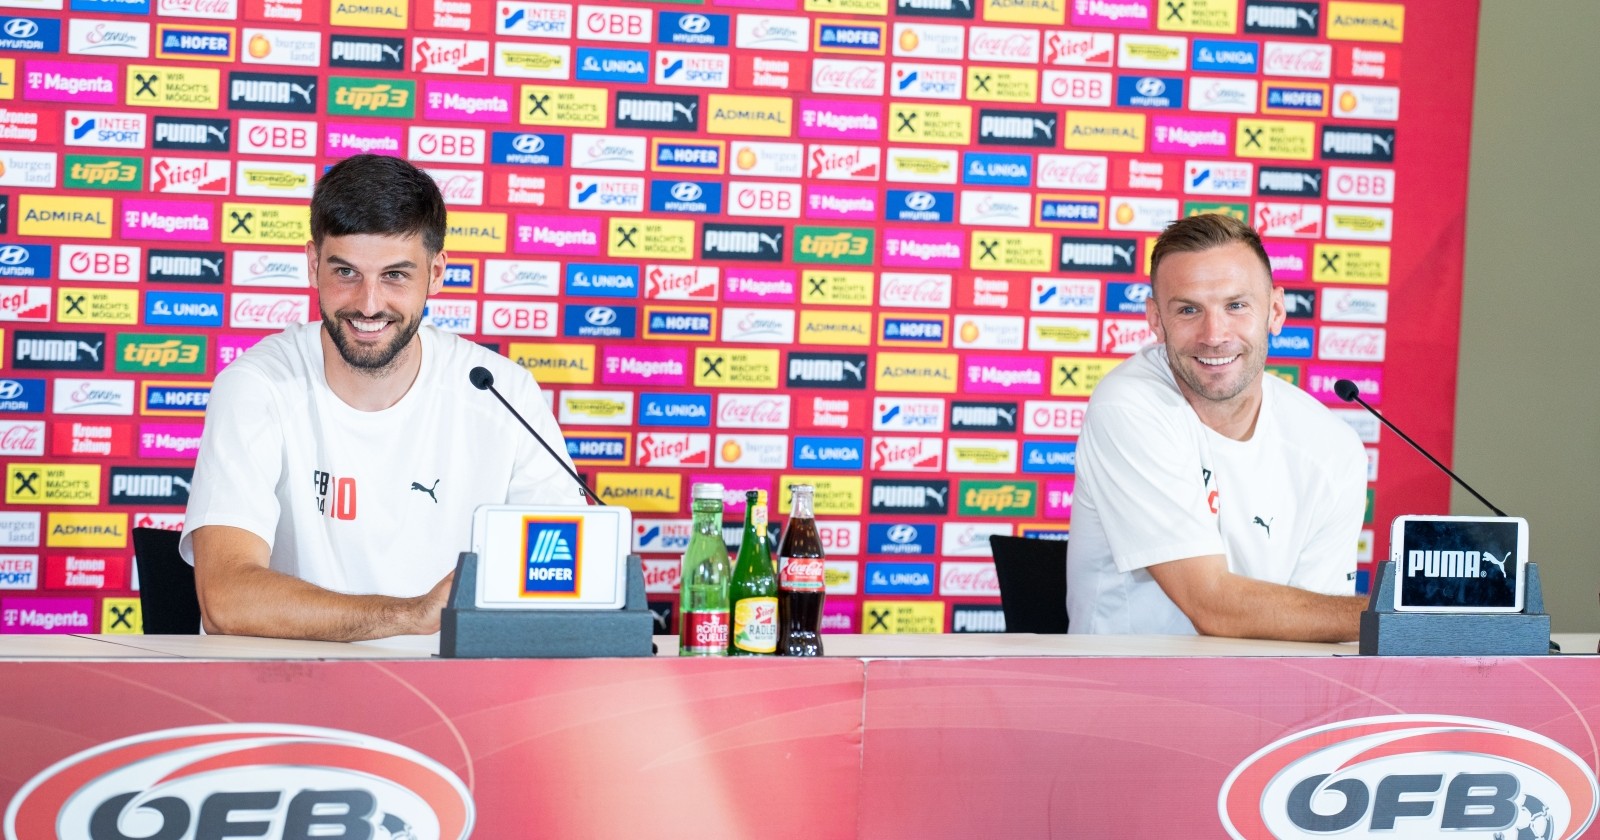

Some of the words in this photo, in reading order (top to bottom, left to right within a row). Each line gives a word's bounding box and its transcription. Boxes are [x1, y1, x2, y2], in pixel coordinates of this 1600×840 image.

[264, 3, 302, 21] Zeitung
[337, 4, 402, 18] ADMIRAL
[528, 10, 566, 20] INTER
[1247, 6, 1297, 28] PUMA
[528, 21, 565, 32] SPORT
[181, 36, 227, 50] HOFER
[276, 37, 315, 49] burgen
[837, 31, 878, 44] HOFER
[290, 51, 315, 62] land
[332, 41, 382, 61] PUMA
[412, 41, 467, 72] Stiegl
[1046, 34, 1094, 64] Stiegl
[603, 61, 644, 74] UNIQA
[686, 59, 724, 70] INTER
[686, 71, 722, 81] SPORT
[922, 70, 956, 80] INTER
[45, 74, 113, 94] Magenta
[231, 80, 291, 103] PUMA
[335, 85, 409, 110] tipp3
[444, 93, 507, 113] Magenta
[618, 100, 674, 122] PUMA
[714, 109, 785, 123] ADMIRAL
[100, 118, 140, 130] INTER
[817, 111, 878, 131] Magenta
[981, 116, 1033, 138] PUMA
[99, 131, 139, 143] SPORT
[156, 123, 207, 143] PUMA
[1072, 124, 1138, 139] ADMIRAL
[342, 133, 398, 151] Magenta
[507, 154, 549, 164] HYUNDAI
[674, 150, 717, 163] HOFER
[808, 148, 860, 178] Stiegl
[9, 159, 50, 171] burgen
[71, 161, 137, 184] tipp3
[987, 164, 1027, 177] UNIQA
[24, 172, 50, 183] land
[151, 159, 208, 192] Stiegl
[602, 183, 638, 192] INTER
[601, 195, 636, 205] SPORT
[25, 209, 106, 224] ADMIRAL
[1056, 204, 1098, 218] HOFER
[142, 212, 208, 232] Magenta
[535, 226, 596, 247] Magenta
[705, 231, 760, 252] PUMA
[801, 233, 868, 258] tipp3
[901, 240, 960, 260] Magenta
[1062, 243, 1114, 265] PUMA
[151, 257, 201, 275] PUMA
[592, 275, 633, 288] UNIQA
[646, 268, 698, 298] Stiegl
[740, 279, 793, 296] Magenta
[174, 304, 217, 316] UNIQA
[433, 306, 471, 315] INTER
[432, 318, 469, 328] SPORT
[666, 317, 708, 330] HOFER
[806, 322, 866, 334] ADMIRAL
[900, 323, 942, 336] HOFER
[16, 339, 77, 361] PUMA
[123, 341, 199, 366] tipp3
[516, 355, 588, 371] ADMIRAL
[621, 358, 683, 377] Magenta
[789, 360, 843, 381] PUMA
[882, 367, 949, 379] ADMIRAL
[981, 368, 1041, 385] Magenta
[665, 405, 706, 416] UNIQA
[952, 407, 998, 425] PUMA
[72, 423, 112, 438] Kronen
[72, 439, 111, 455] Zeitung
[580, 441, 623, 455] HOFER
[637, 436, 689, 465] Stiegl
[819, 448, 859, 460] UNIQA
[873, 442, 921, 469] Stiegl
[113, 475, 172, 496] PUMA
[602, 486, 674, 499] ADMIRAL
[331, 477, 356, 520] 10
[872, 486, 925, 506] PUMA
[9, 531, 34, 542] land
[53, 524, 122, 536] ADMIRAL
[662, 526, 690, 536] INTE
[66, 557, 105, 571] Kronen
[1408, 551, 1479, 578] PUMA
[66, 573, 104, 588] Zeitung
[529, 568, 572, 581] HOFER
[890, 573, 929, 585] UNIQA
[20, 610, 88, 629] Magenta
[955, 611, 1006, 631] PUMA
[697, 633, 728, 643] QUELLE
